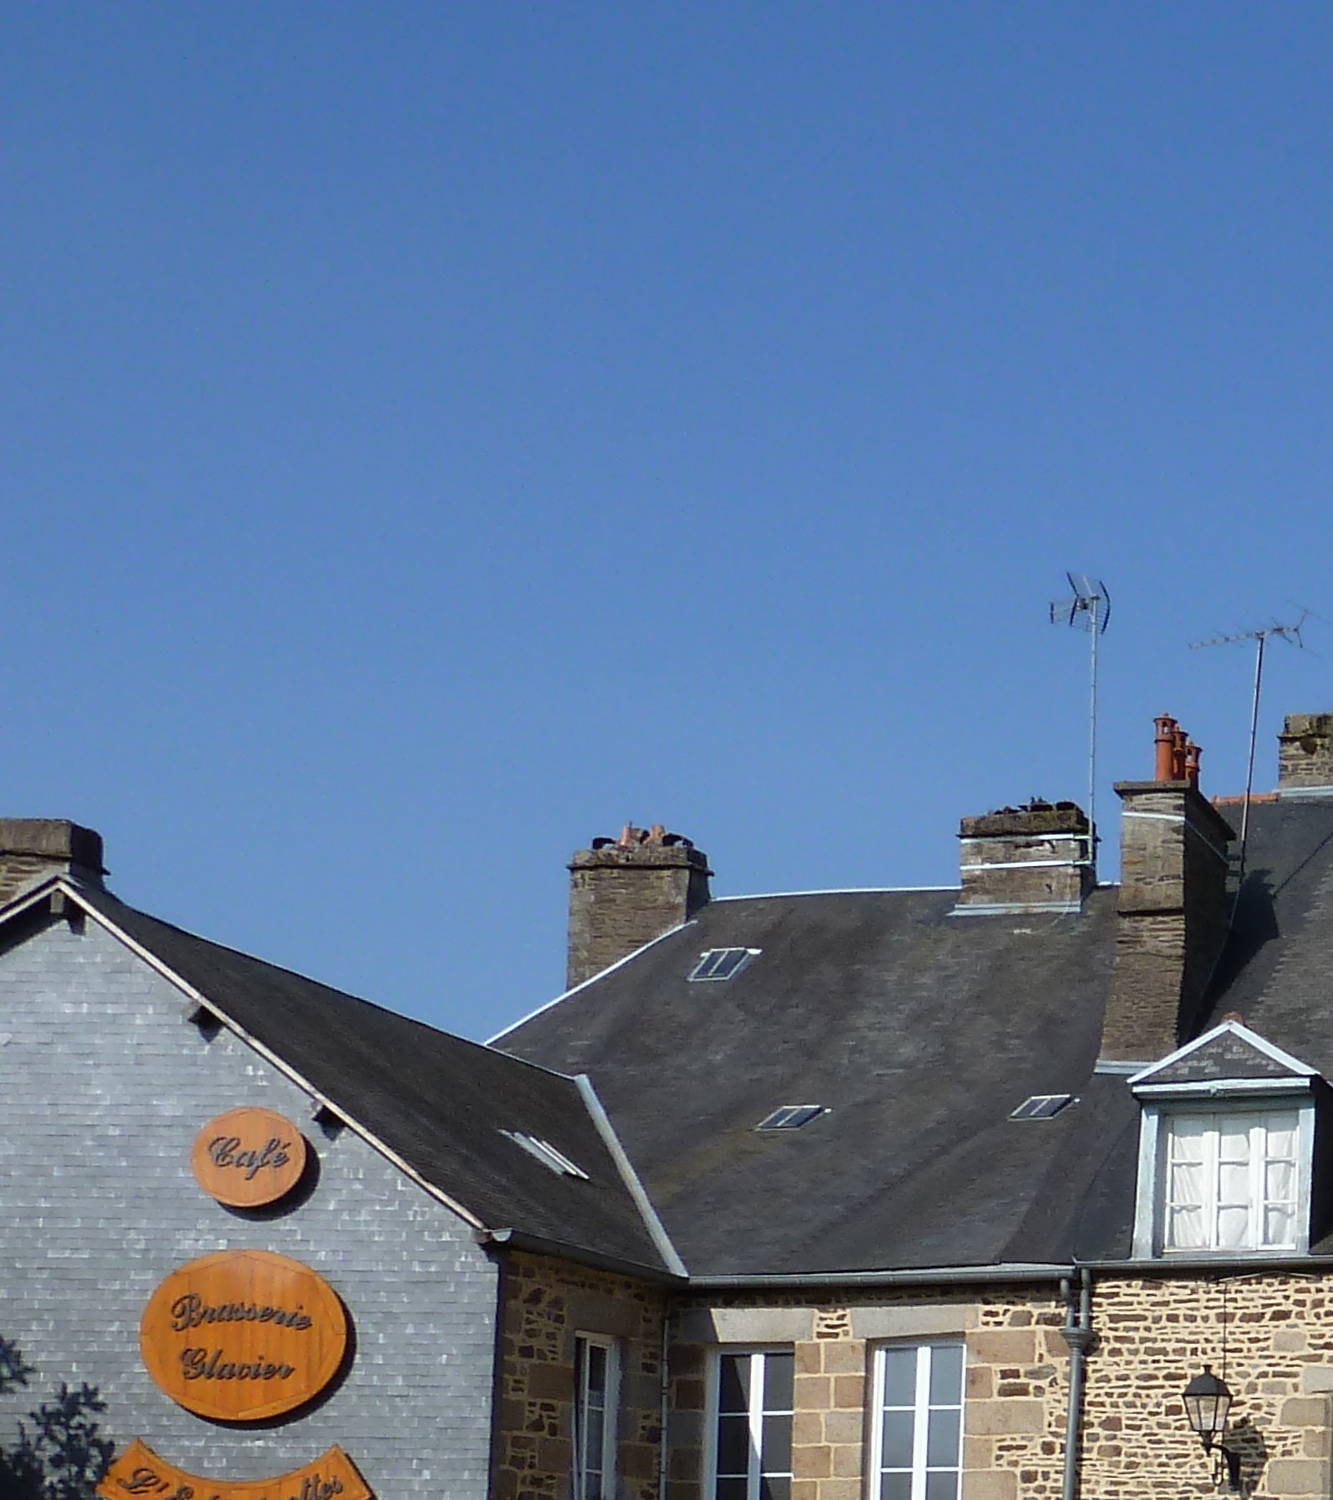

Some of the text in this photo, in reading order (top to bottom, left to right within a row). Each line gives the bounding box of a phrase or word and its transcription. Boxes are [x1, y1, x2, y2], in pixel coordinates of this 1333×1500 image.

[207, 1136, 292, 1181] Café
[170, 1292, 313, 1332] Brasserie
[180, 1346, 297, 1380] Glacier
